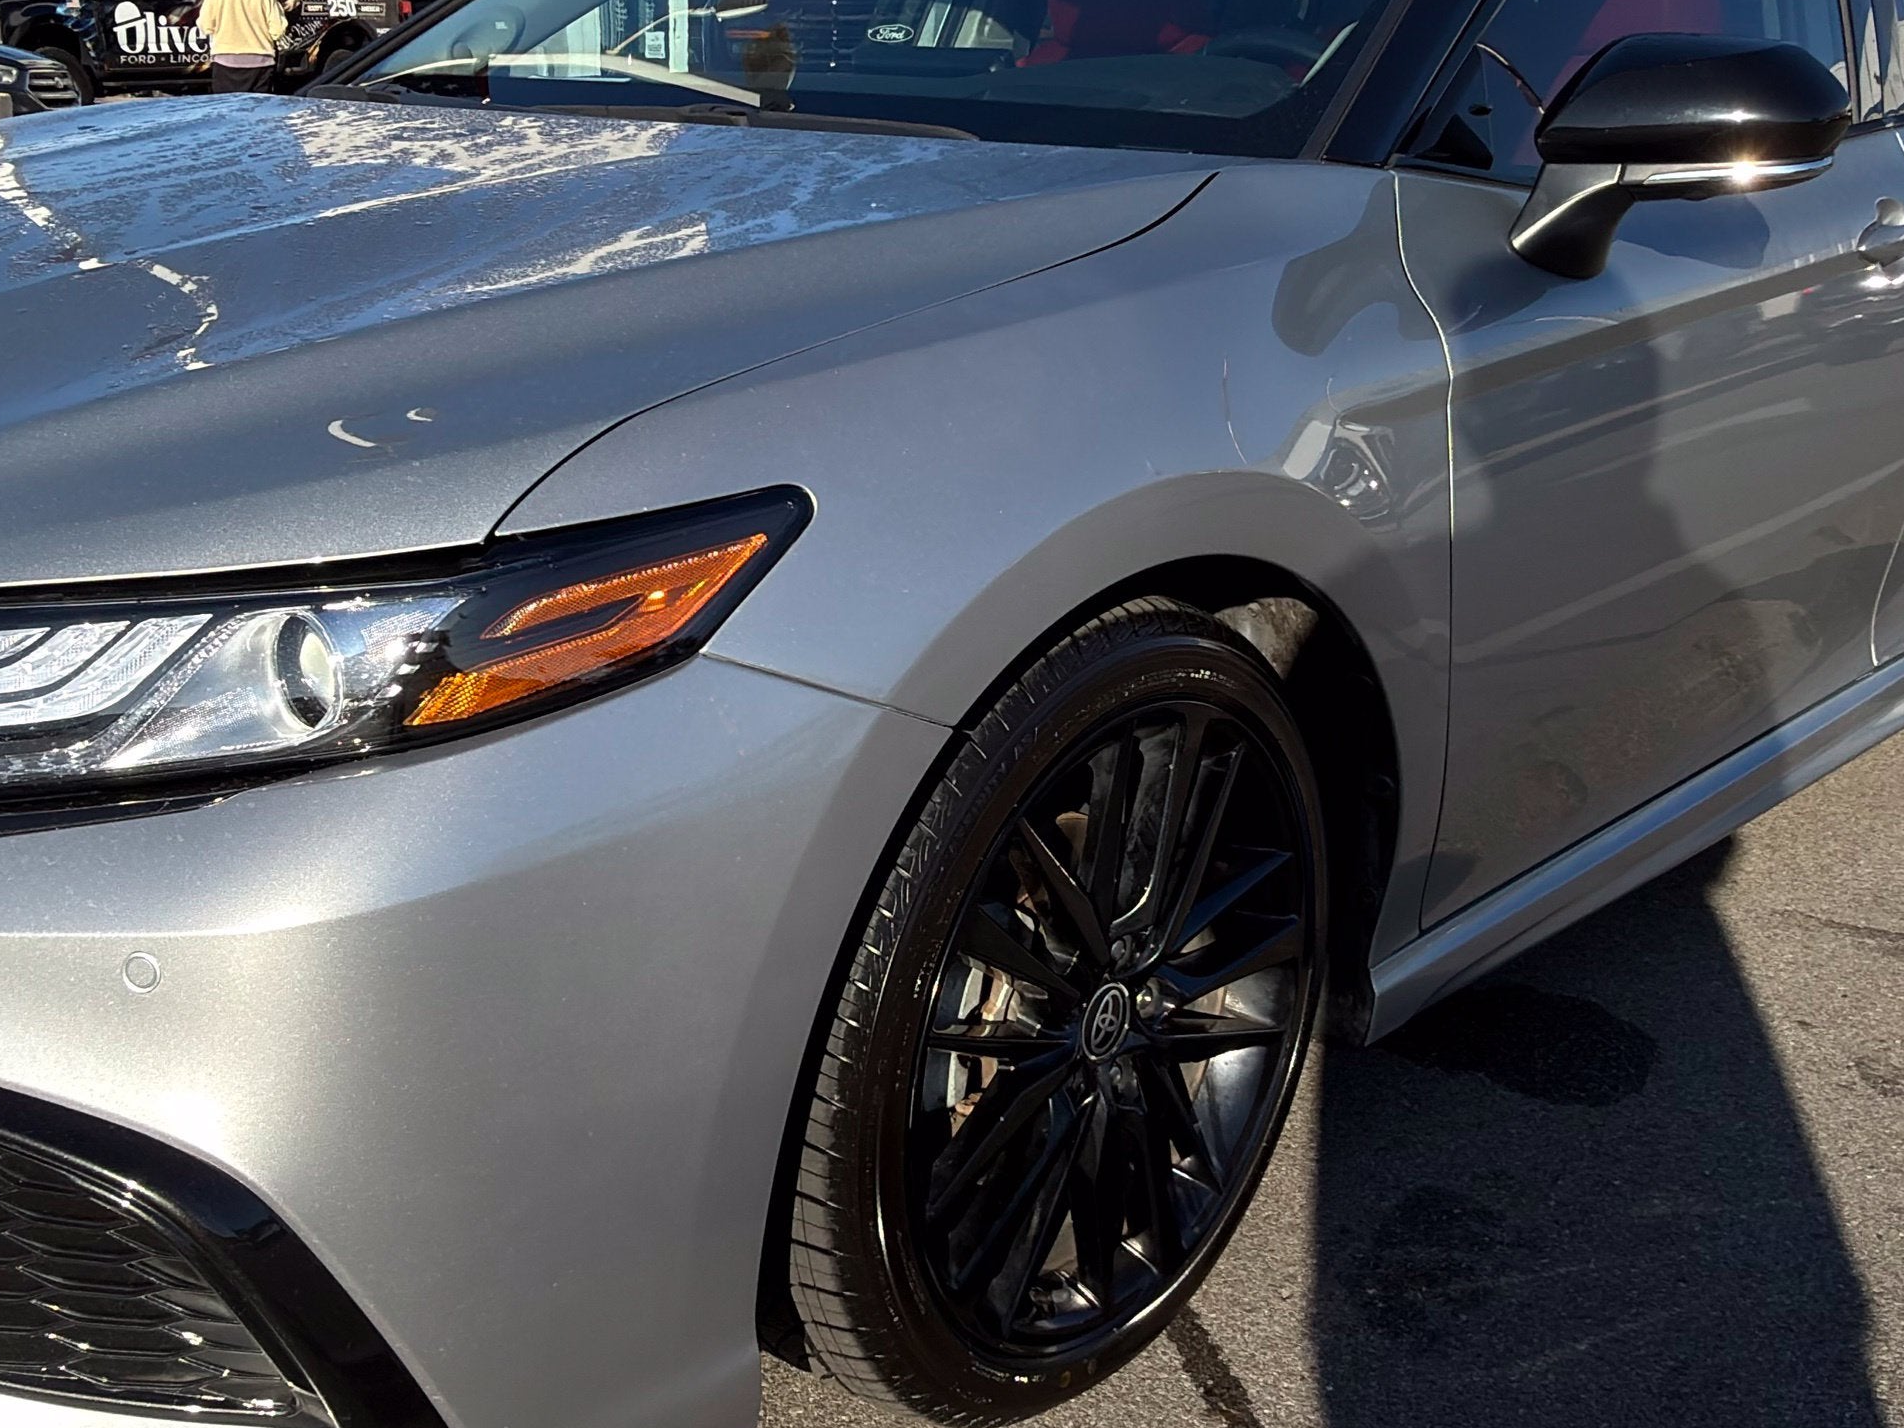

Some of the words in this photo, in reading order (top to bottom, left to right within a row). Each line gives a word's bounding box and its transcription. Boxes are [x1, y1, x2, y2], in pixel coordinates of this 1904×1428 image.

[113, 1, 212, 54] Olive
[877, 27, 905, 39] Ford
[120, 54, 156, 64] FORD
[170, 53, 211, 63] LINCO
